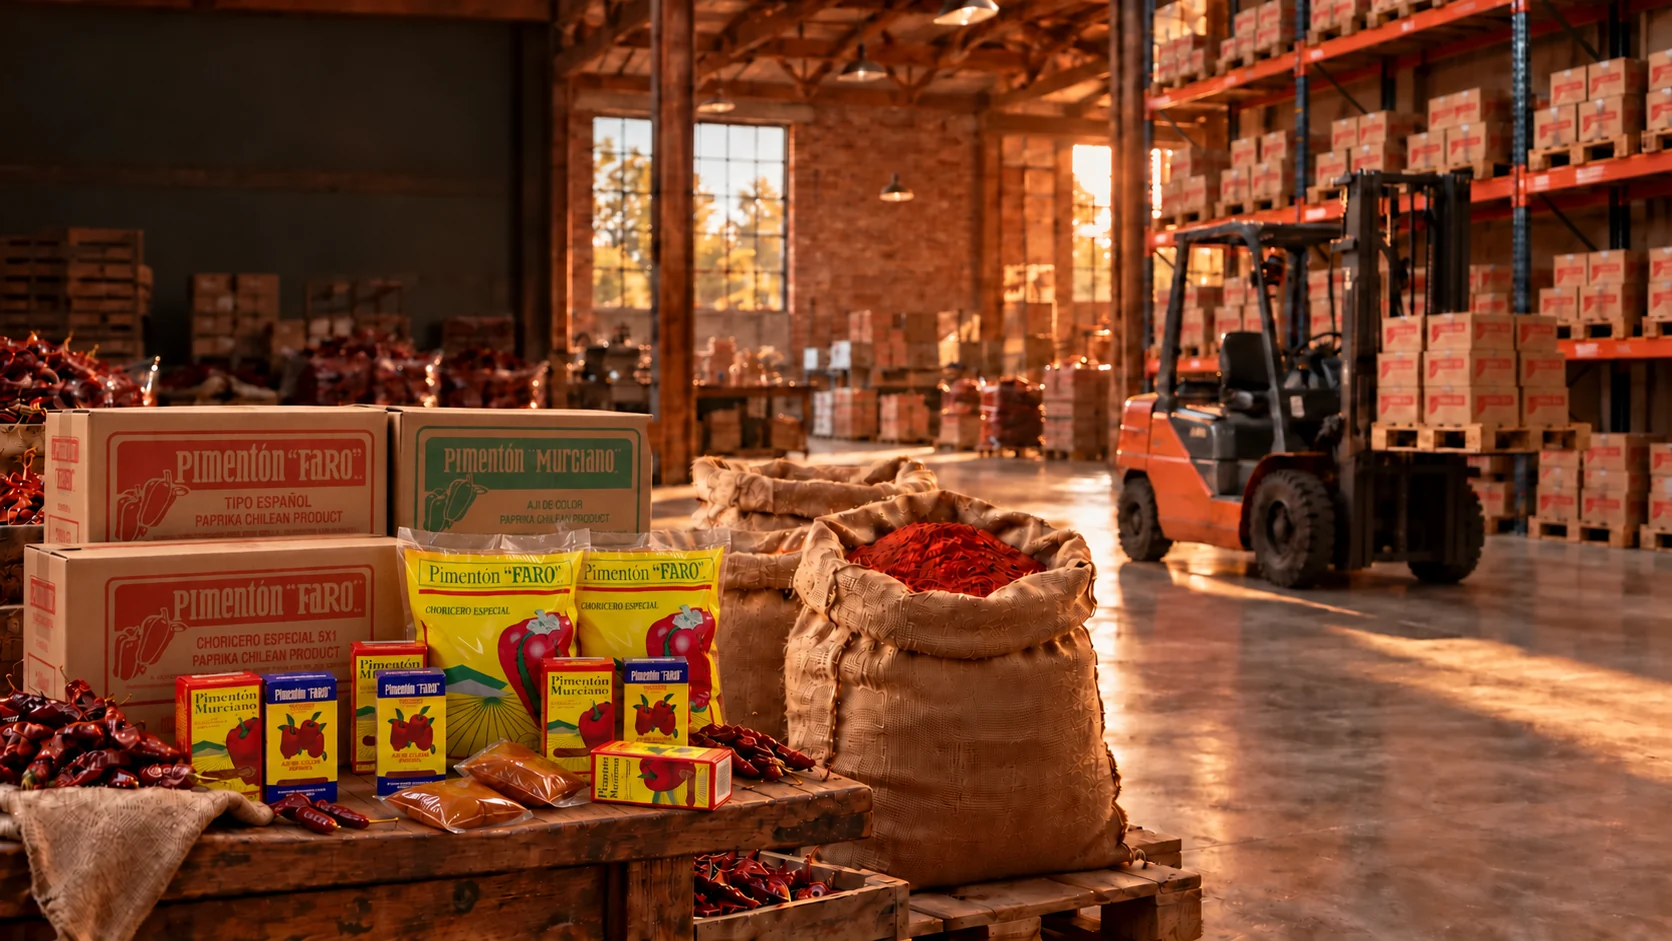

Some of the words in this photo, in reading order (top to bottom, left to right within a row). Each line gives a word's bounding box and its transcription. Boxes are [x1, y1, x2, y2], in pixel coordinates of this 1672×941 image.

[225, 496, 253, 509] TIPO
[257, 492, 312, 509] ESPAÑOL
[543, 500, 553, 510] DE
[555, 500, 583, 510] COLOR
[195, 513, 242, 527] PAPRIKA
[245, 512, 290, 526] CHILEAN
[293, 510, 343, 524] PRODUCT
[500, 514, 534, 525] PAPRIKA
[573, 513, 610, 524] PRODUCT
[429, 564, 500, 584] Pimentón
[584, 563, 649, 581] Pimentón
[425, 605, 472, 616] CHORICERO
[473, 606, 510, 616] ESPECIAL
[625, 600, 659, 610] ESPECIAL
[196, 633, 260, 650] CHORICERO
[263, 631, 315, 647] ESPECIAL
[318, 630, 337, 643] 5X1
[192, 652, 239, 667] PAPRIKA
[242, 649, 287, 663] CHILEAN
[289, 646, 341, 661] PRODUCT
[360, 658, 420, 670] Pimentón
[551, 675, 609, 686] Pimentón
[195, 689, 257, 704] Pimentón
[551, 686, 609, 696] Murciano
[195, 702, 257, 714] Murciano
